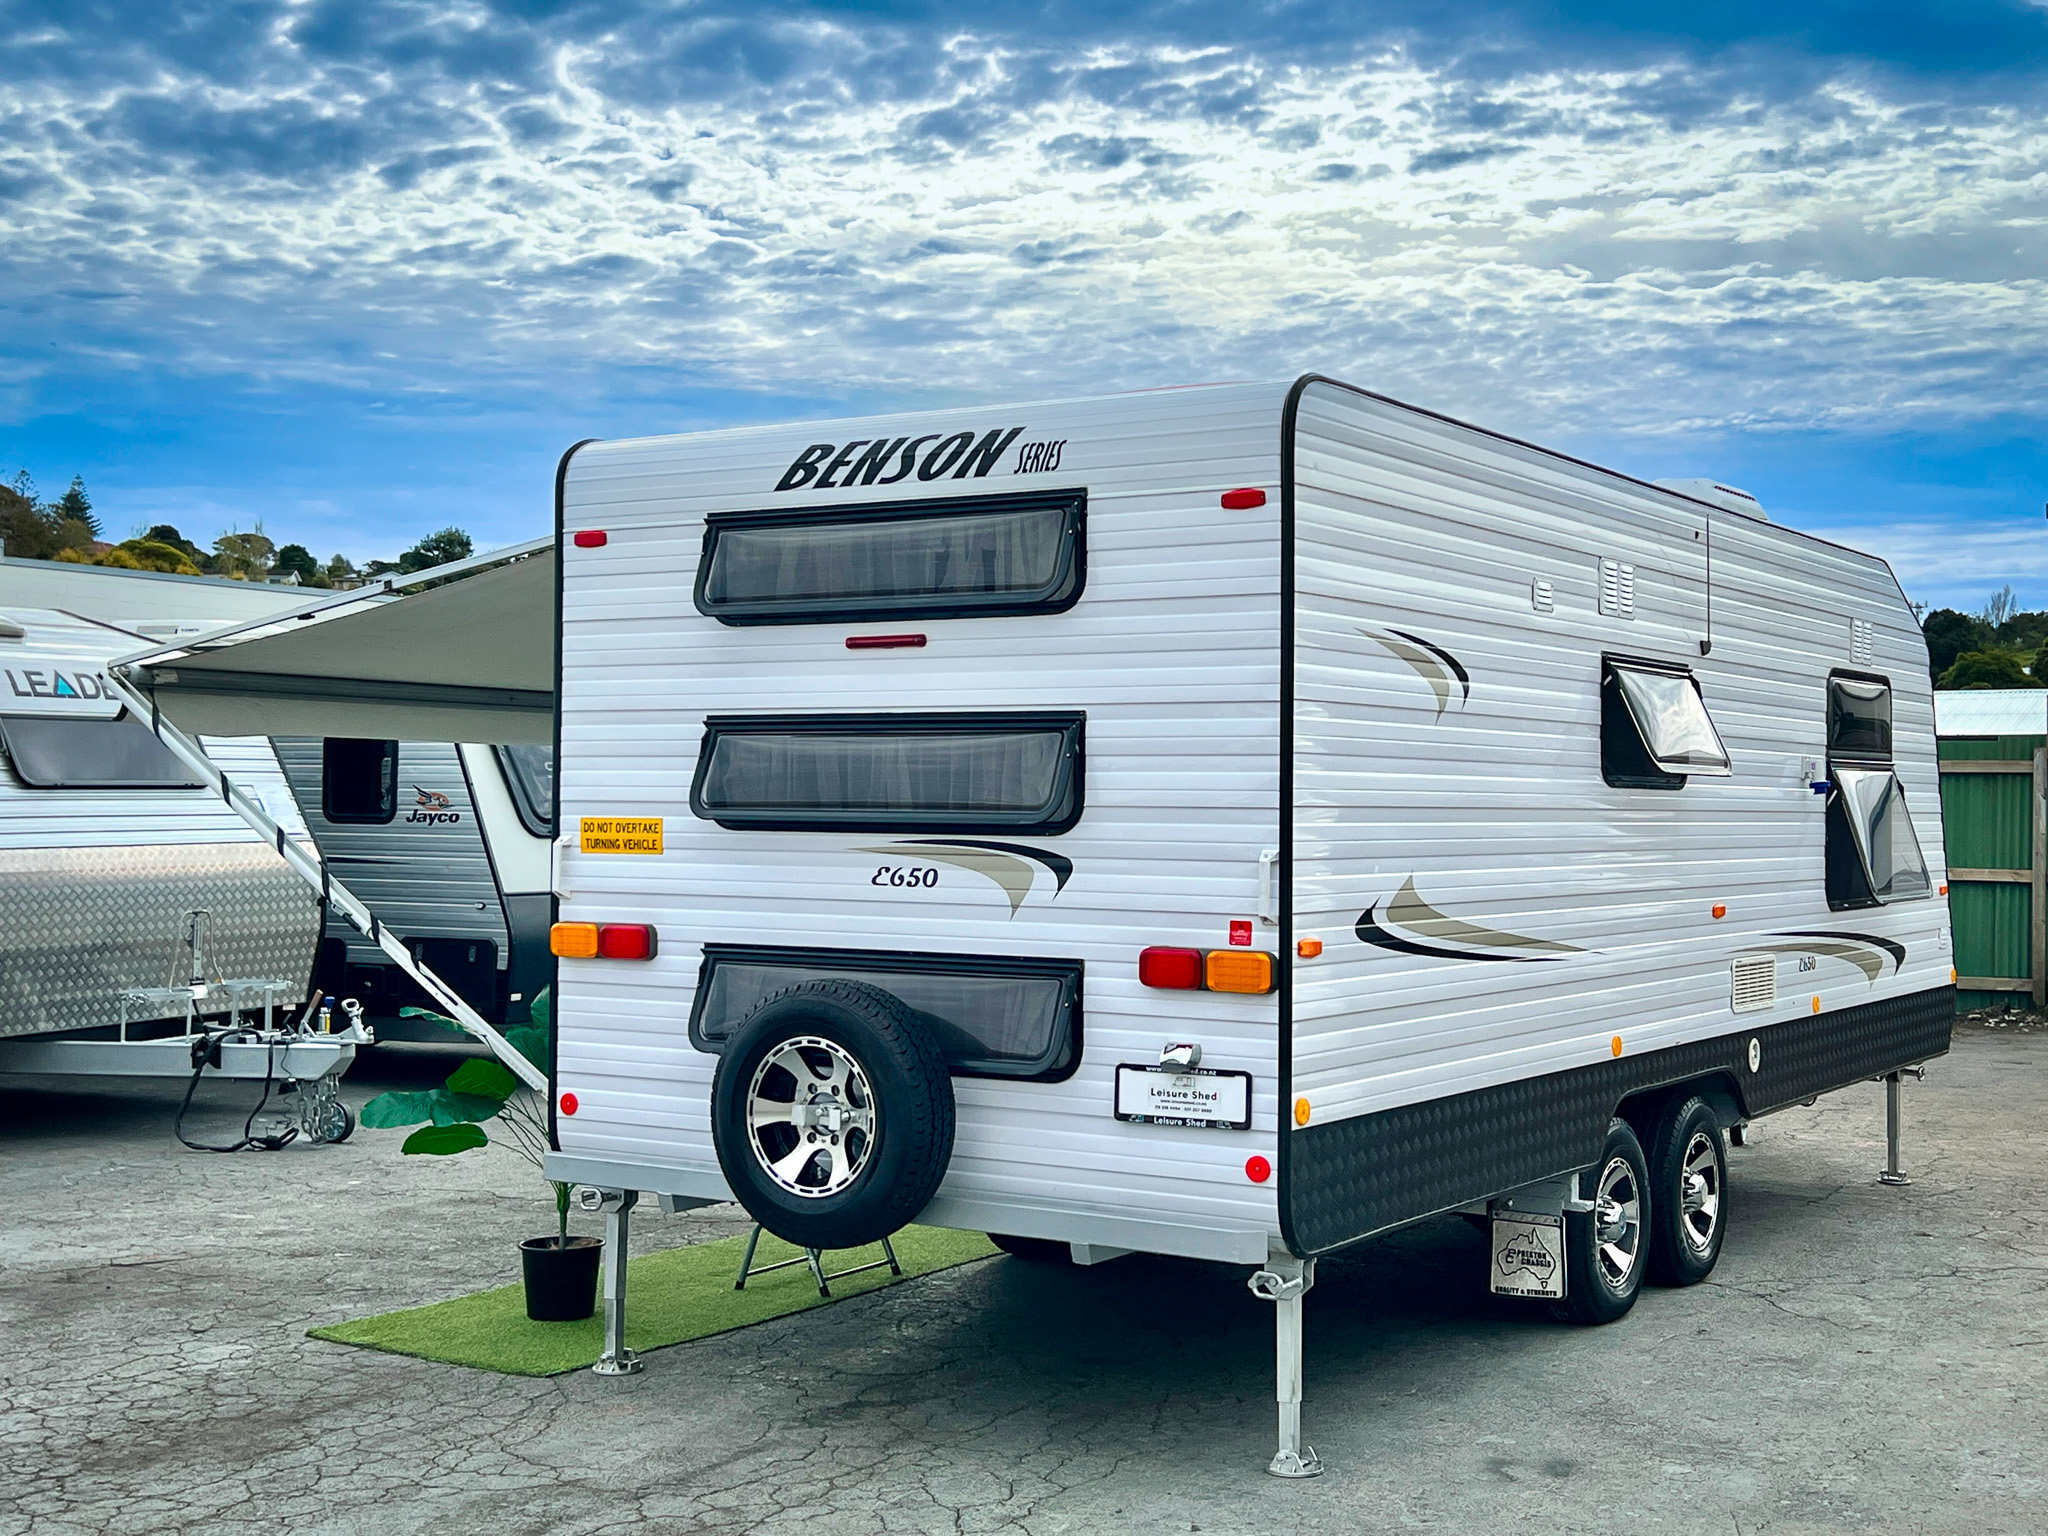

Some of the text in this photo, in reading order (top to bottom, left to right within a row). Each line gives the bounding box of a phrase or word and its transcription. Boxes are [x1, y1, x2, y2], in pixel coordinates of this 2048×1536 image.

[773, 426, 1068, 492] BENSON SERIES
[405, 808, 460, 826] Jayco
[583, 822, 659, 834] DO NOT OVERTAKE
[585, 838, 658, 851] TURNING VEHICLE
[871, 866, 939, 888] E650
[1150, 1087, 1217, 1101] Leisure Shed
[1153, 1116, 1207, 1128] Leisure Shed
[1517, 1249, 1546, 1259] PRESTON
[1521, 1258, 1551, 1267] CHASSIS
